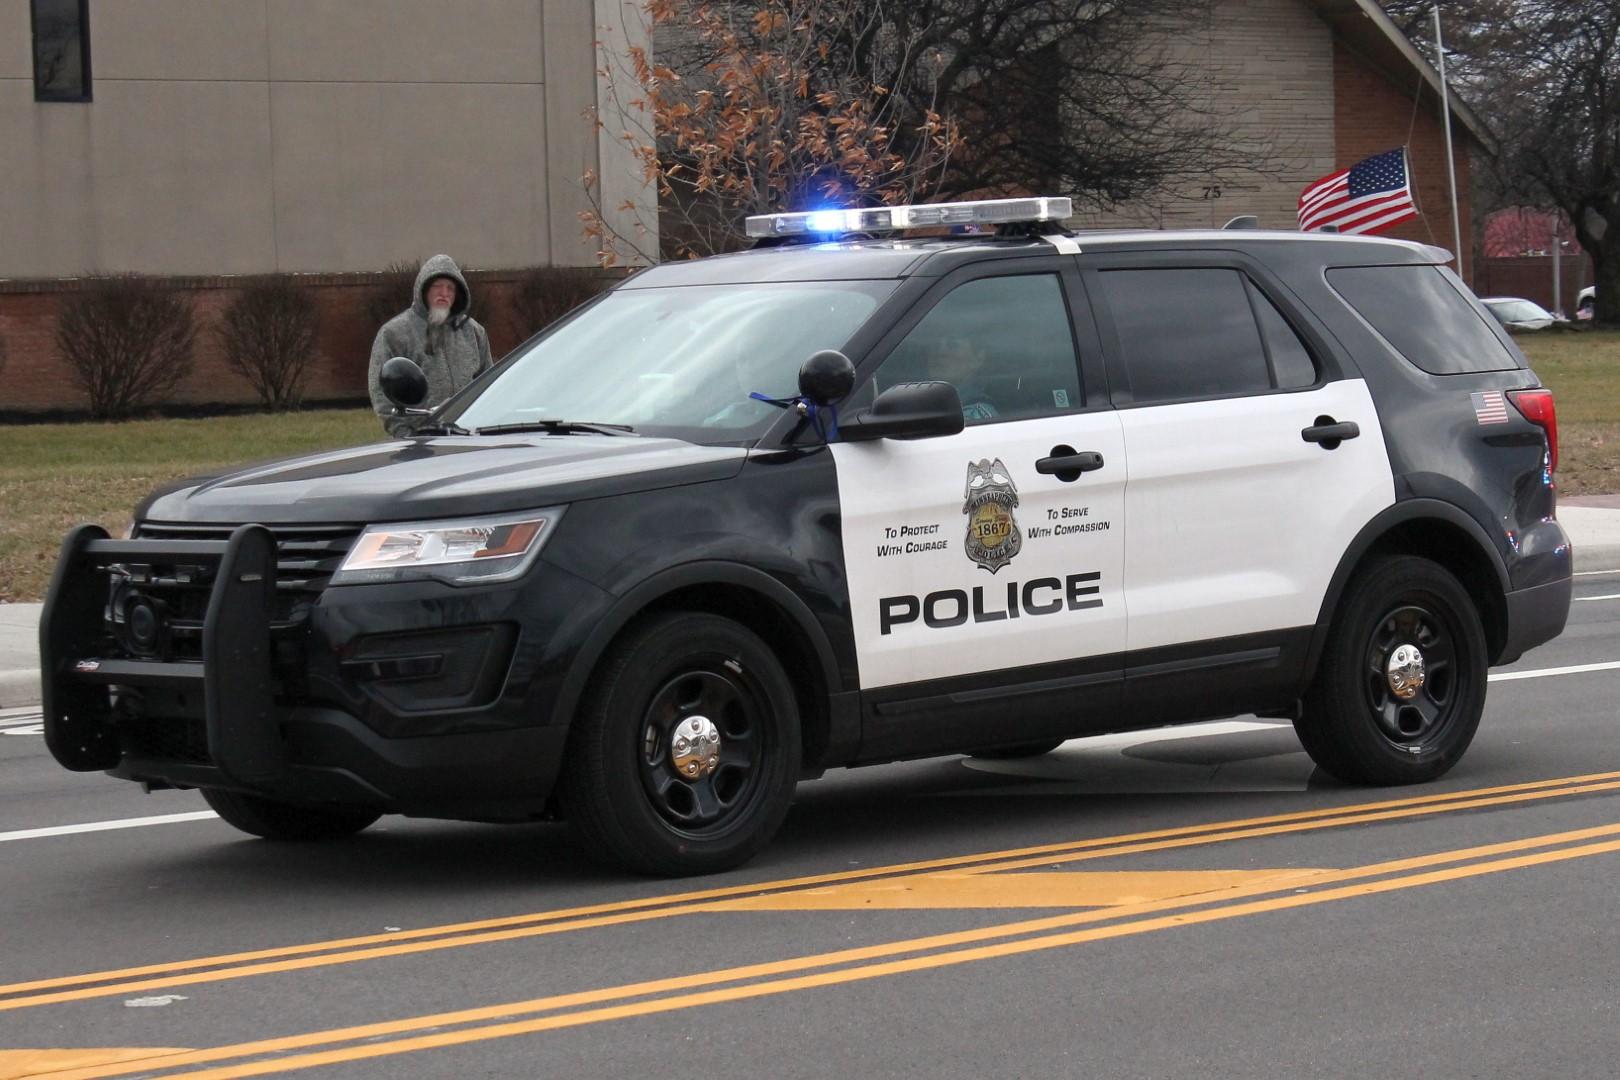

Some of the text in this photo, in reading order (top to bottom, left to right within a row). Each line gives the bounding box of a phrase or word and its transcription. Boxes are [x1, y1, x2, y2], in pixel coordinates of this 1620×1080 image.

[1202, 185, 1221, 200] 75
[978, 522, 1006, 536] 1867
[879, 571, 1104, 636] POLICE
